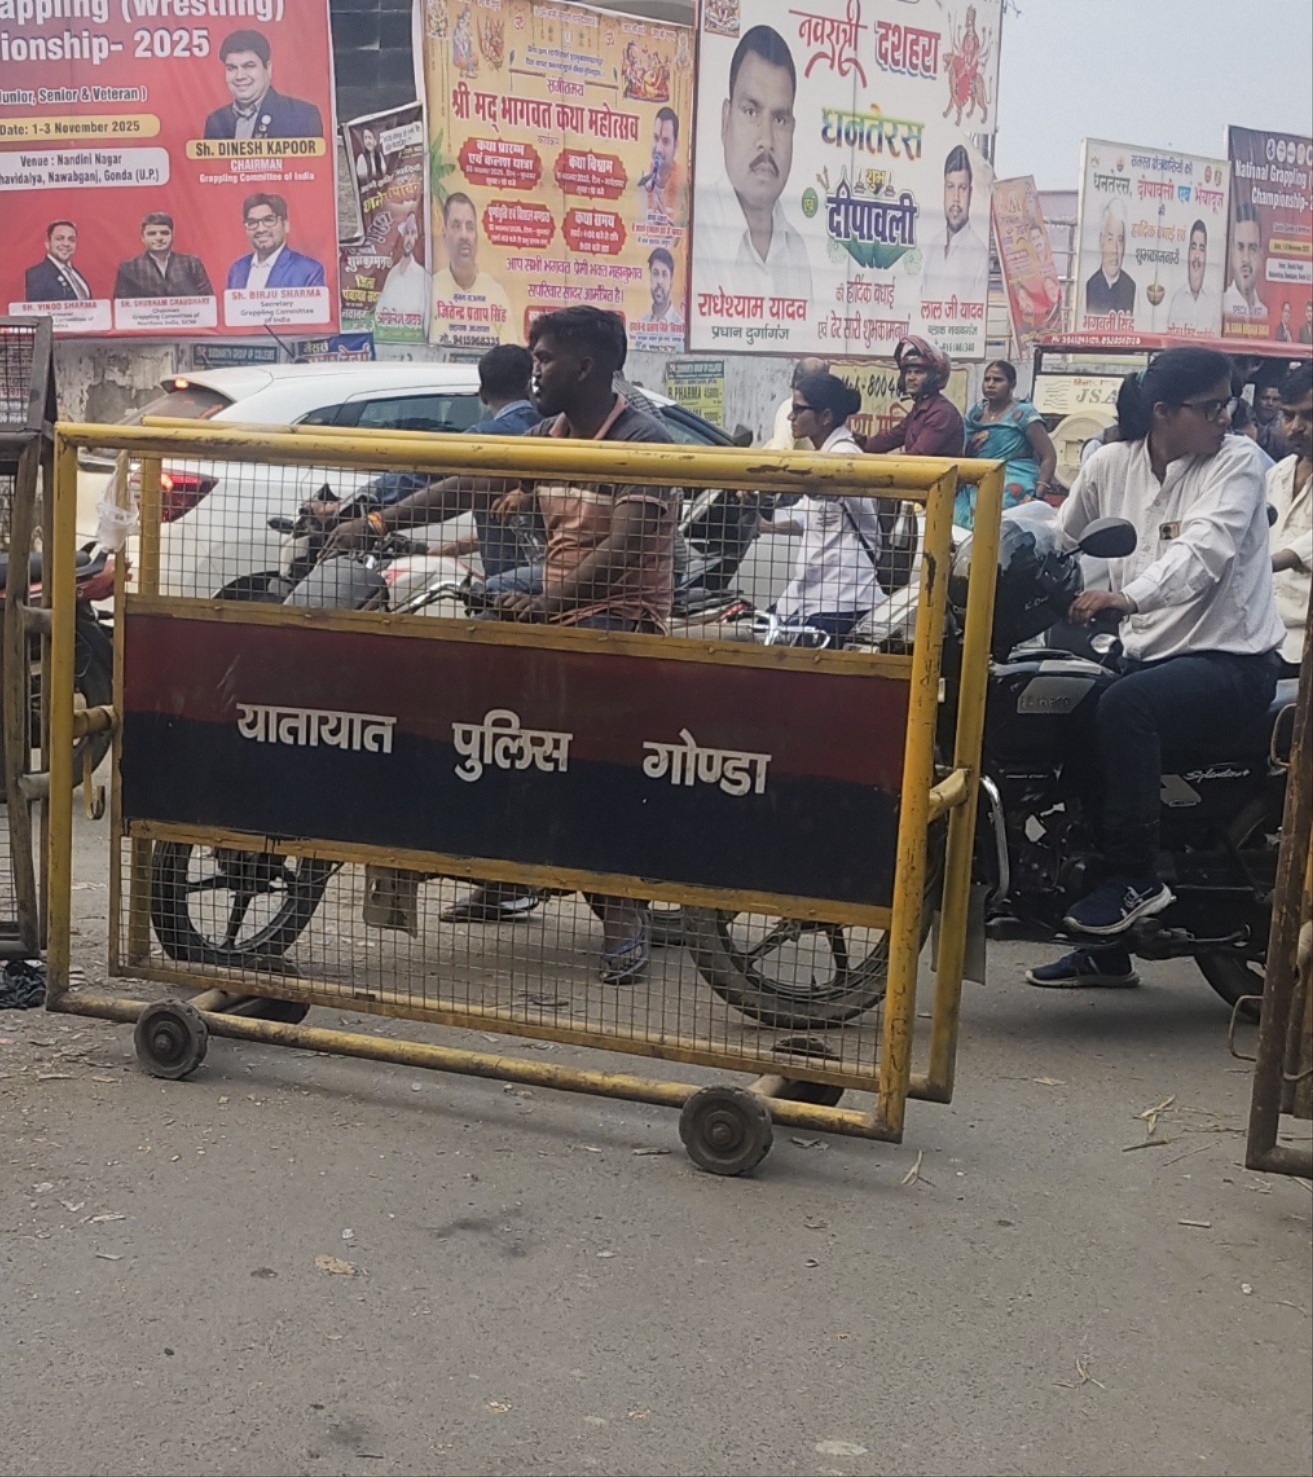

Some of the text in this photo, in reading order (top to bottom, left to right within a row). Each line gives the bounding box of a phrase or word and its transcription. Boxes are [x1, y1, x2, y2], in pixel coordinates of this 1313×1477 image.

[120, 0, 286, 22] (Wrestling)
[133, 29, 211, 59] 2025
[875, 20, 941, 79] दशहरा
[39, 88, 78, 104] Senior
[81, 87, 89, 100] &
[92, 86, 138, 101] Veteran
[451, 79, 640, 141] श्री मद् भागवत कथा महोत्सव
[0, 120, 140, 136] Date: 1-3 November 2025
[196, 139, 317, 156] Sh. DINESH KAPOOR
[20, 155, 48, 167] Venue
[57, 153, 92, 166] Nandini
[94, 152, 122, 166] Nagar
[230, 159, 283, 172] CHAIRMAN
[104, 169, 133, 182] Gonda
[199, 171, 315, 184] Grappling Committee of India
[865, 168, 887, 191] शुभ
[1234, 159, 1307, 190] National Grappling
[1137, 174, 1175, 201] दीपावली
[1177, 181, 1193, 204] एवं
[826, 178, 918, 247] दीपावली
[506, 257, 523, 272] आप
[524, 257, 543, 273] सभी
[573, 257, 589, 276] प्रेमी
[590, 262, 608, 279] भक्त
[231, 288, 321, 301] Sh. BIRJU SHARMA
[528, 281, 562, 299] सपरिवार
[563, 285, 584, 301] सादर
[846, 273, 873, 304] हार्दिक
[38, 302, 62, 311] VINOD
[64, 301, 97, 309] SHARMA
[240, 308, 275, 317] Grappling
[260, 300, 294, 308] Secretary
[490, 303, 507, 323] सिंह
[697, 285, 808, 322] राधेश्याम यादव
[920, 294, 985, 320] लाल जी यादव
[711, 325, 743, 340] प्रधान
[830, 309, 843, 338] ढेर
[844, 310, 862, 340] सारी
[235, 702, 772, 797] यातायात पुलिस गोण्डा
